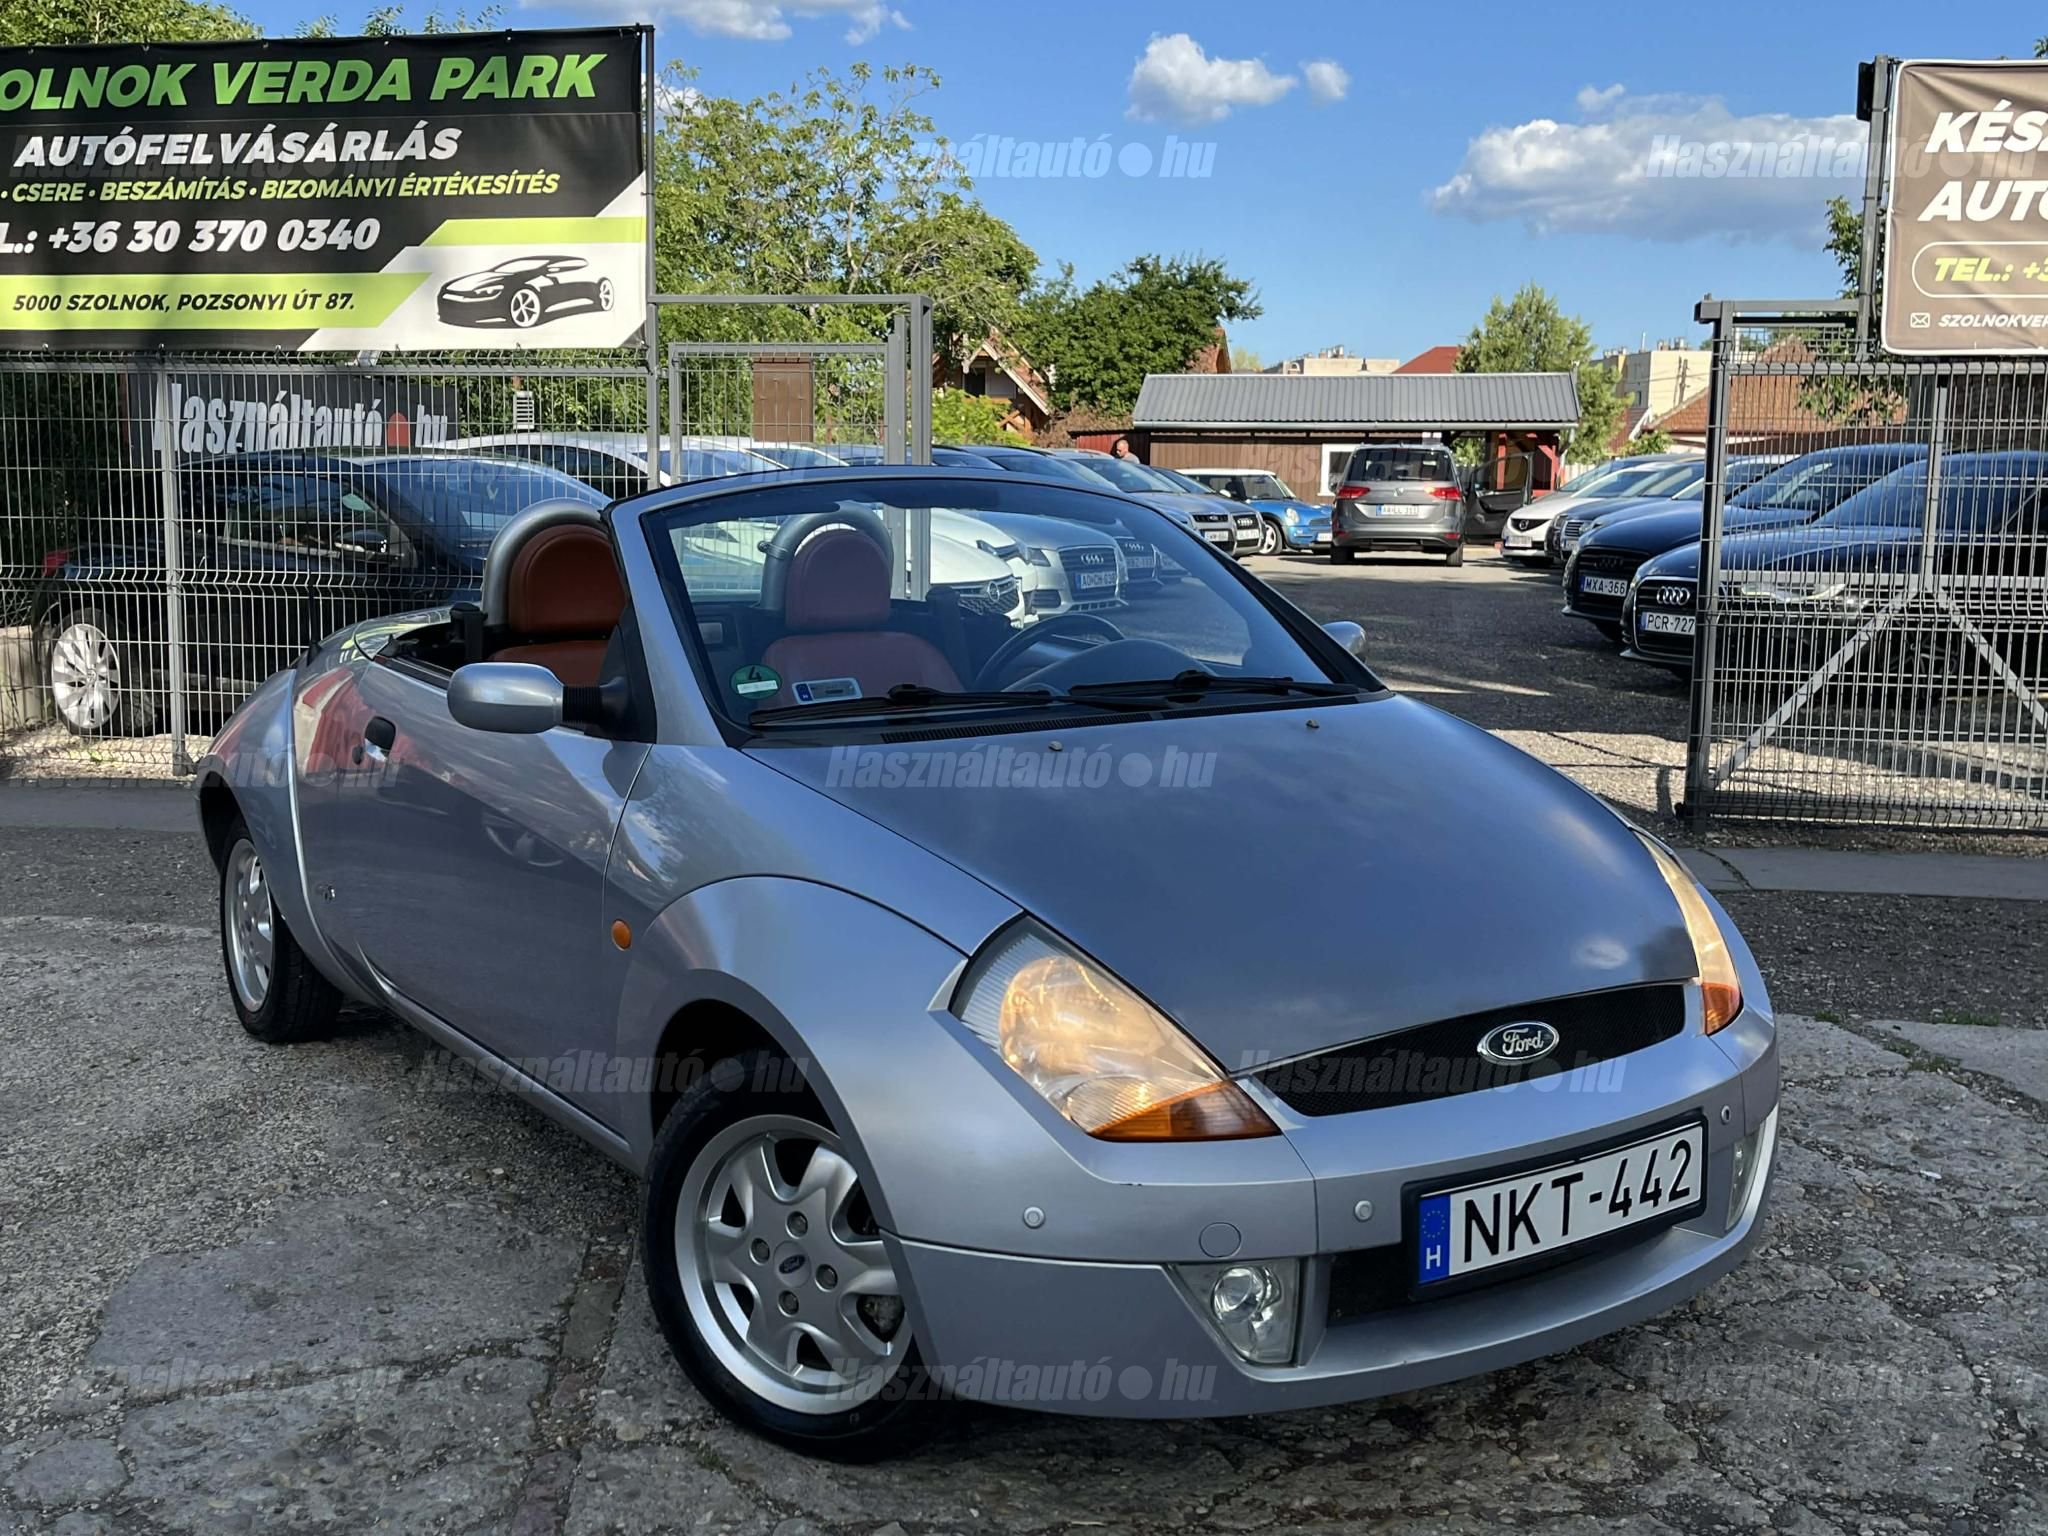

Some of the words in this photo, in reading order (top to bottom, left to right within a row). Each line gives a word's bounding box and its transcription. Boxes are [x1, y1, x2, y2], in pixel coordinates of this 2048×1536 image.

[213, 60, 412, 105] VERDA
[430, 53, 607, 101] PARK
[1925, 99, 2048, 153] KÉS
[13, 120, 463, 168] AUTÓFELVÁSÁRLÁS
[12, 182, 87, 203] CSERE
[99, 175, 247, 201] BESZÁMÍTÁS
[260, 174, 396, 200] BIZOMÁNYI
[399, 169, 561, 197] ÉRTÉKESÍTÉS
[1917, 180, 2048, 222] AUT
[49, 220, 122, 253] +36
[126, 220, 181, 253] 30
[188, 219, 268, 252] 370
[277, 218, 381, 251] 0340
[1935, 257, 2014, 282] TEL.:
[13, 295, 61, 311] 5000
[66, 294, 170, 313] SZOLNOK,
[177, 294, 287, 311] POZSONYI
[292, 290, 321, 310] ÚT
[325, 293, 354, 310] 87.
[1586, 578, 1626, 595] MXA-366
[1648, 613, 1695, 633] PCR-727
[748, 666, 762, 681] 4
[1503, 1027, 1544, 1056] Ford
[1464, 1139, 1692, 1264] NKT-442
[1426, 1245, 1441, 1270] H
